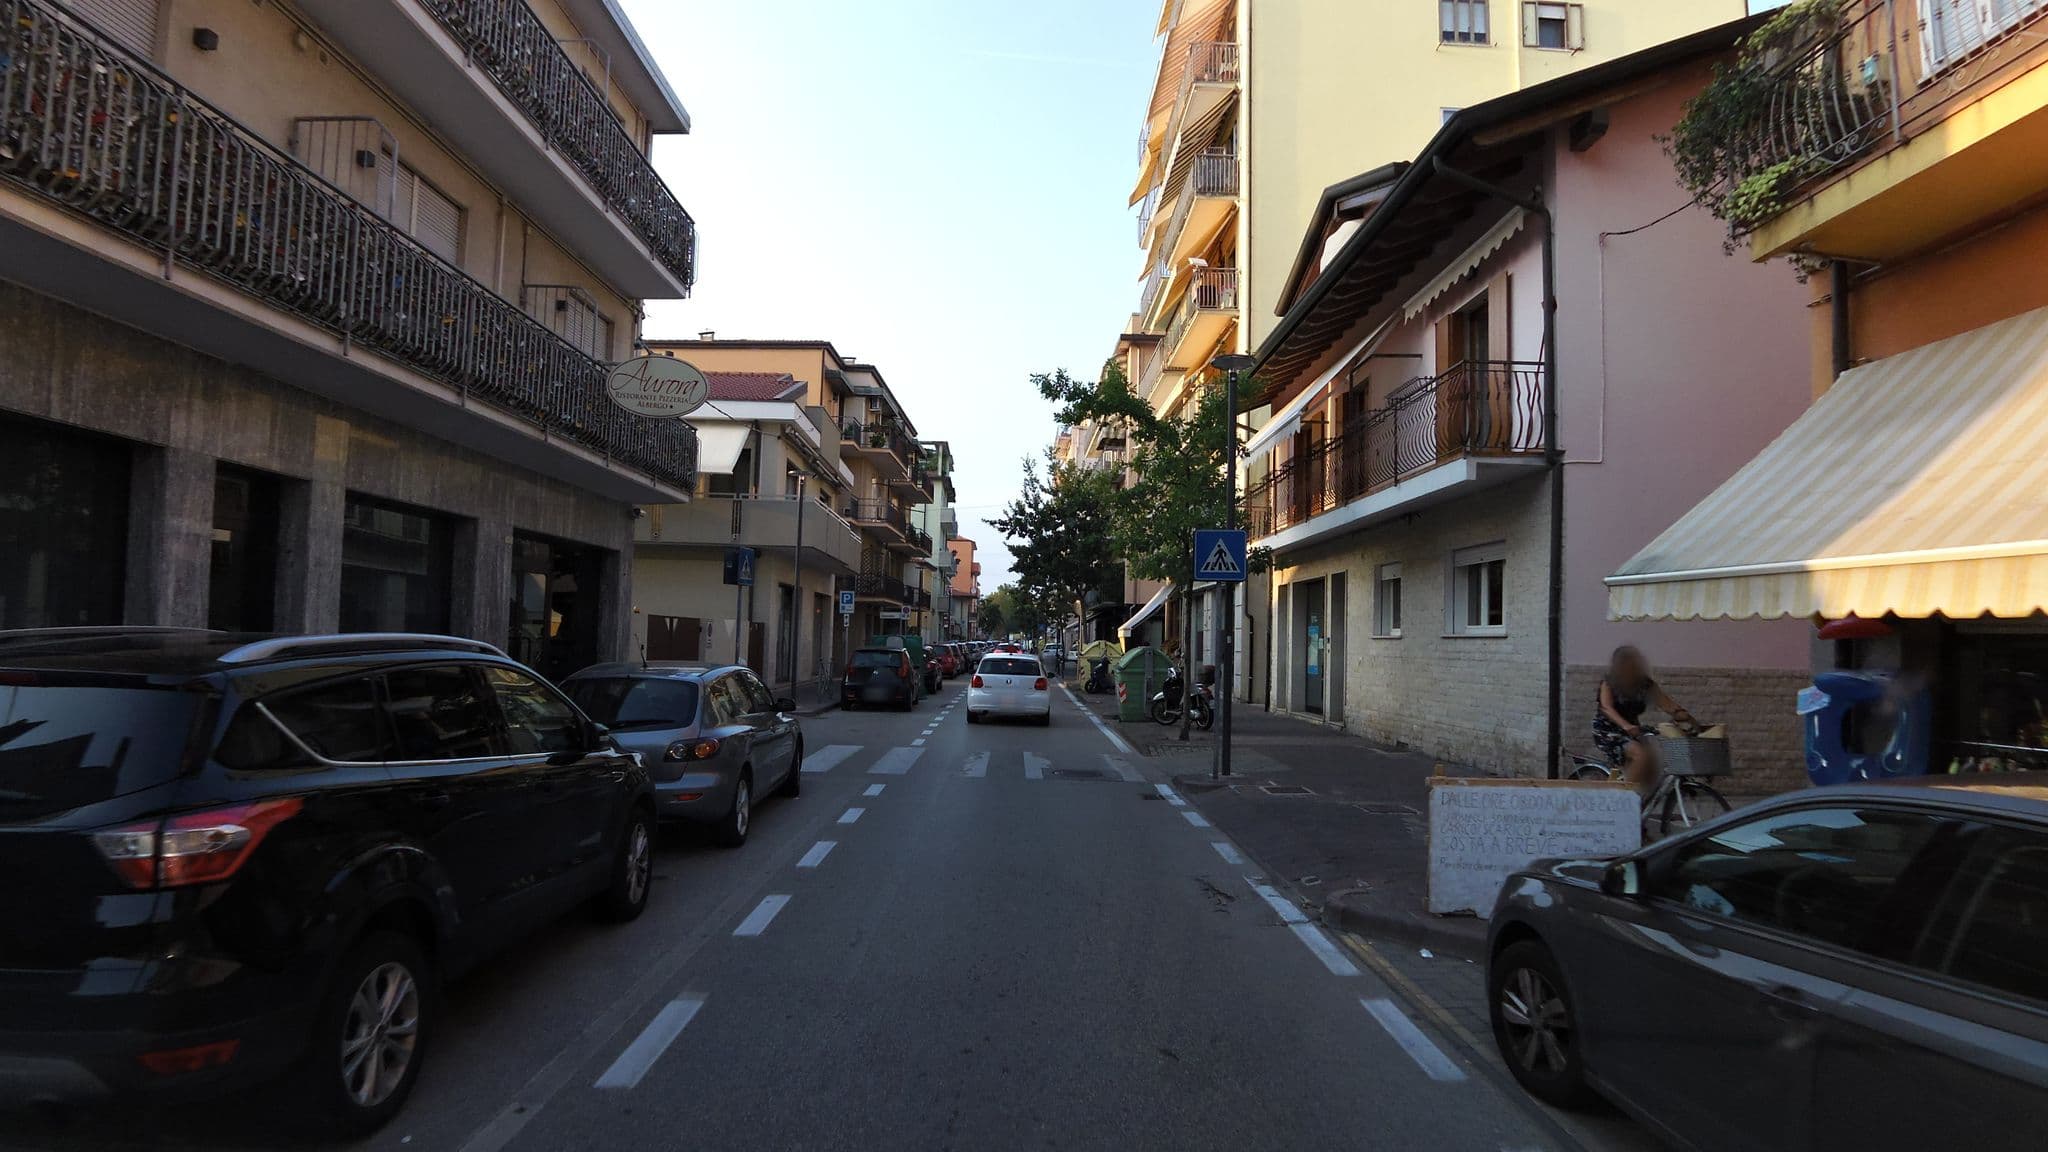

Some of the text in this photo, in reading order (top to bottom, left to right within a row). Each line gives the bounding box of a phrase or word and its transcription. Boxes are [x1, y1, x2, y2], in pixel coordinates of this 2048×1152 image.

[610, 360, 699, 404] Aurora
[615, 391, 689, 404] RISTORANTE PIZZERIA
[638, 400, 668, 409] ALBERGO
[843, 594, 851, 603] P
[1505, 837, 1558, 855] BREVE
